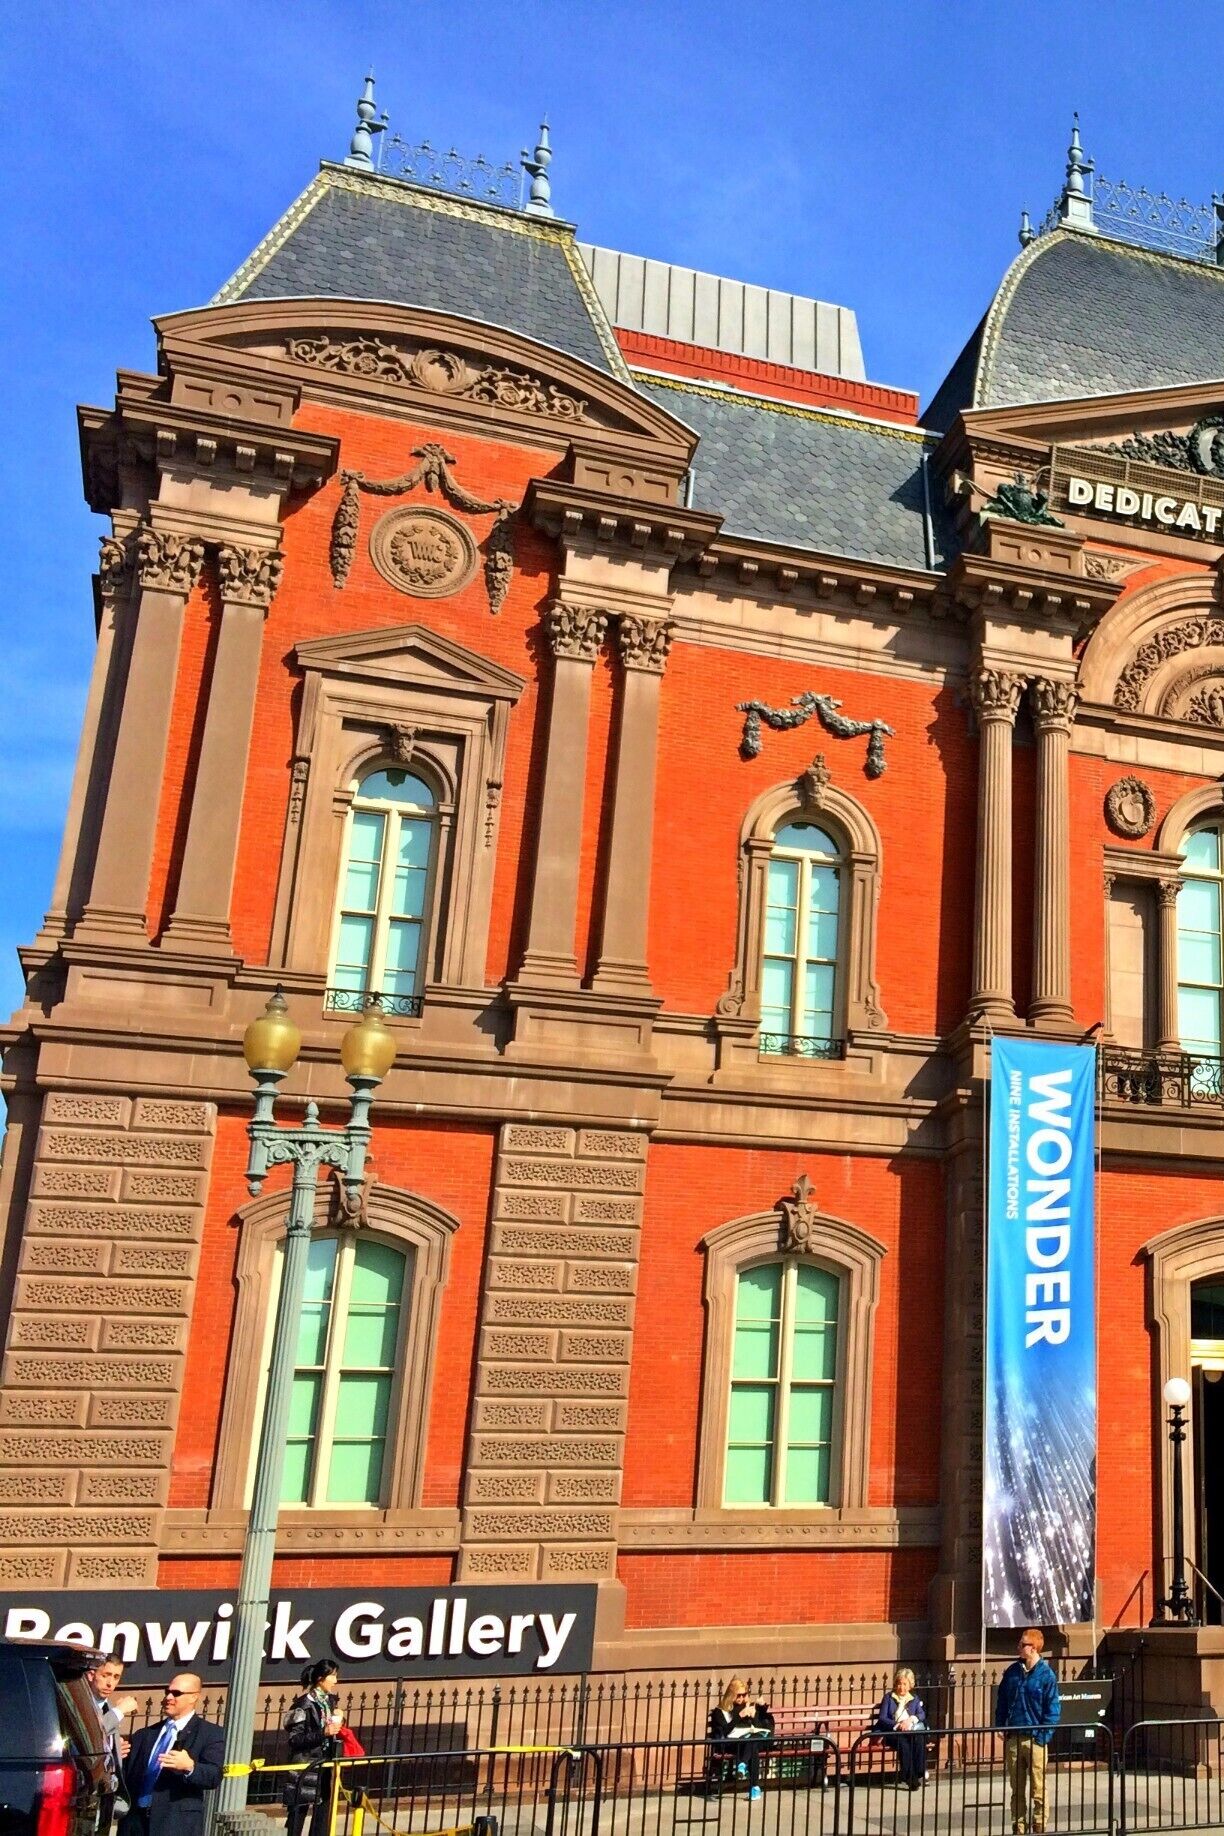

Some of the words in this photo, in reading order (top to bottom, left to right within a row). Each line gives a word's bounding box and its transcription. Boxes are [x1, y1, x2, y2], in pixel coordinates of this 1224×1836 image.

[1008, 1069, 1022, 1106] NINE
[1006, 1108, 1021, 1220] INSTALLATIONS
[1025, 1068, 1073, 1349] WONDER
[5, 1601, 314, 1663] Renwik
[334, 1598, 578, 1669] Gallery
